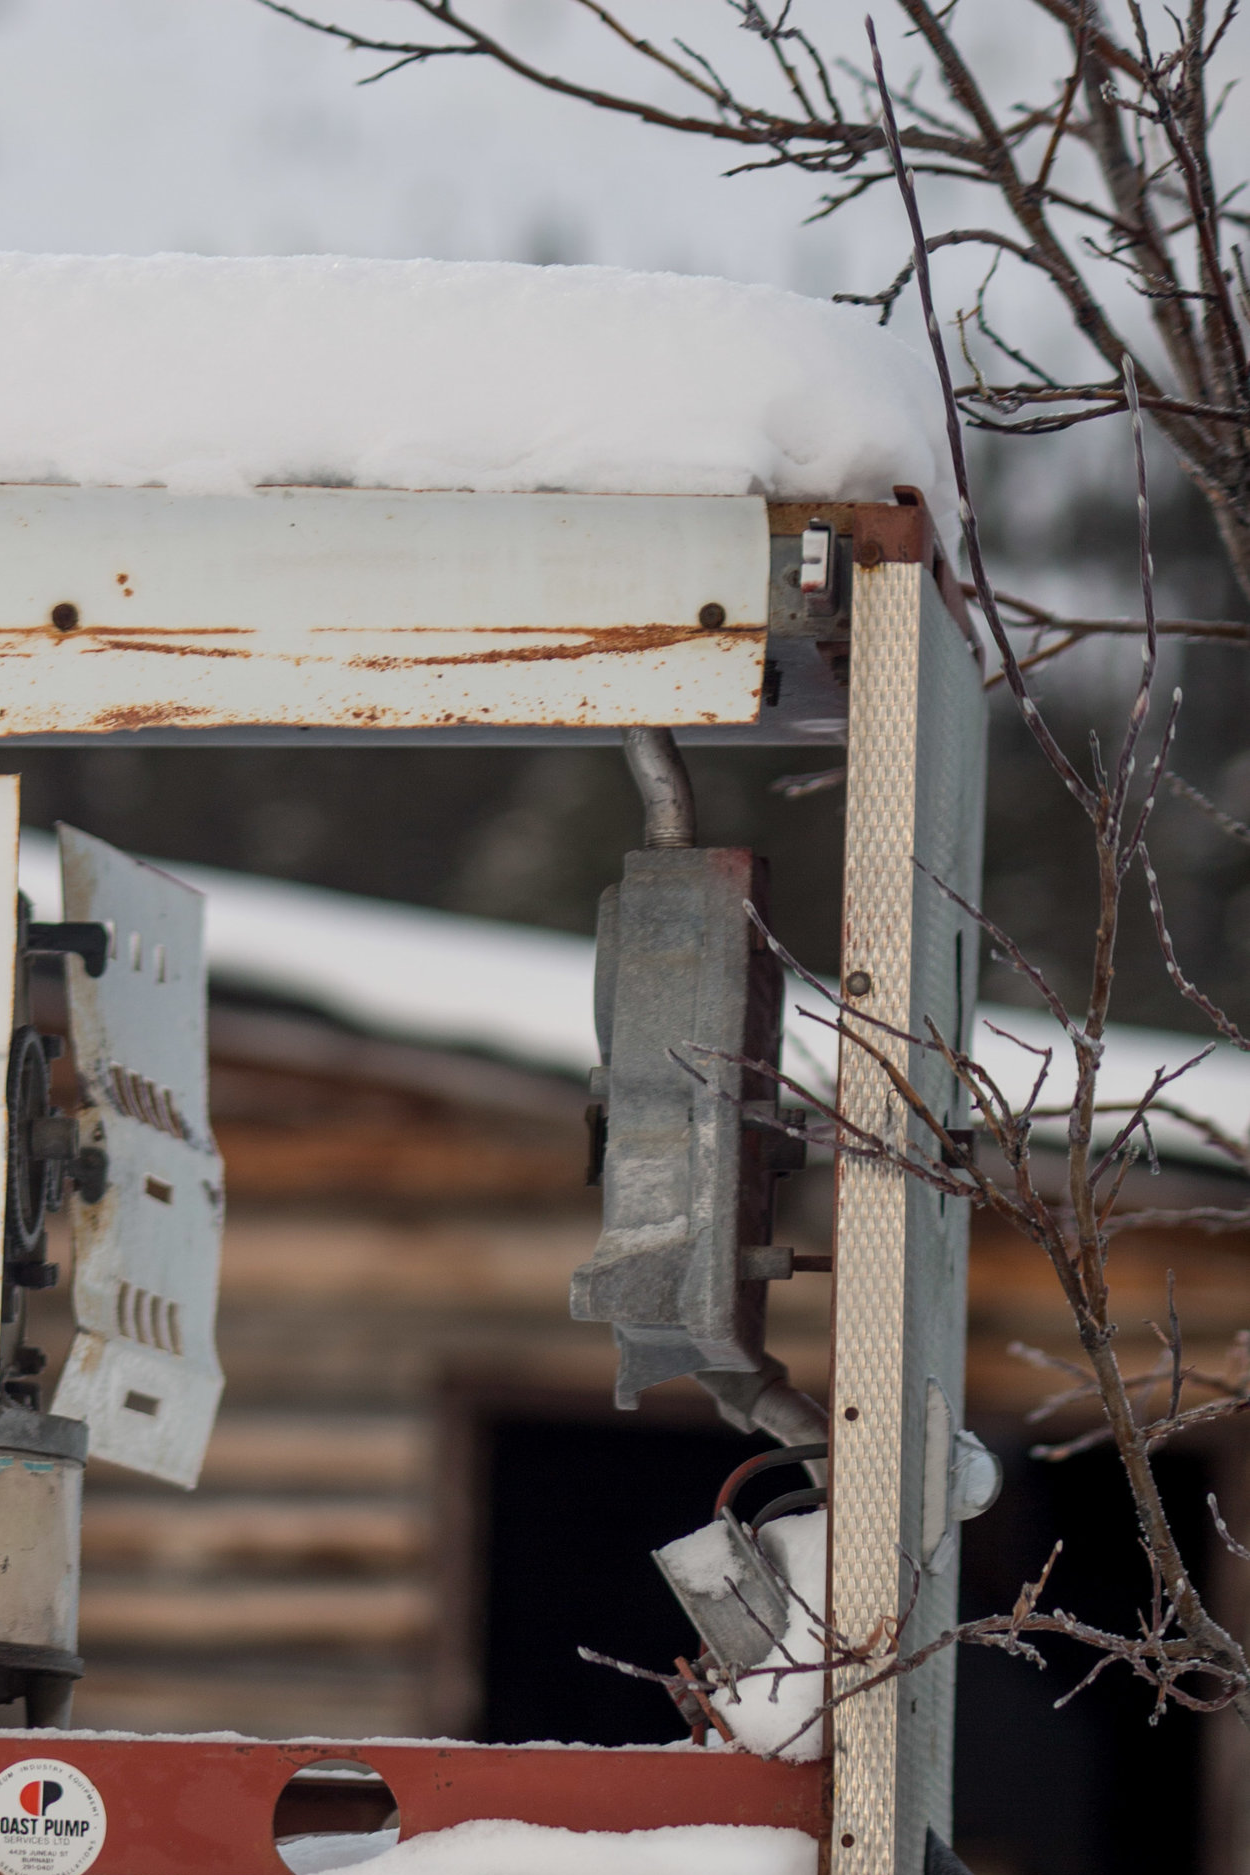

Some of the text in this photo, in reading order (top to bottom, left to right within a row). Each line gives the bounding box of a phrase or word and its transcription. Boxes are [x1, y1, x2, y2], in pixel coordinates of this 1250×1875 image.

[20, 1764, 63, 1774] INDUSTRY
[68, 1774, 100, 1817] EQUIPMENT
[44, 1818, 90, 1838] PUMP
[3, 1835, 71, 1846] SERVICES LTD
